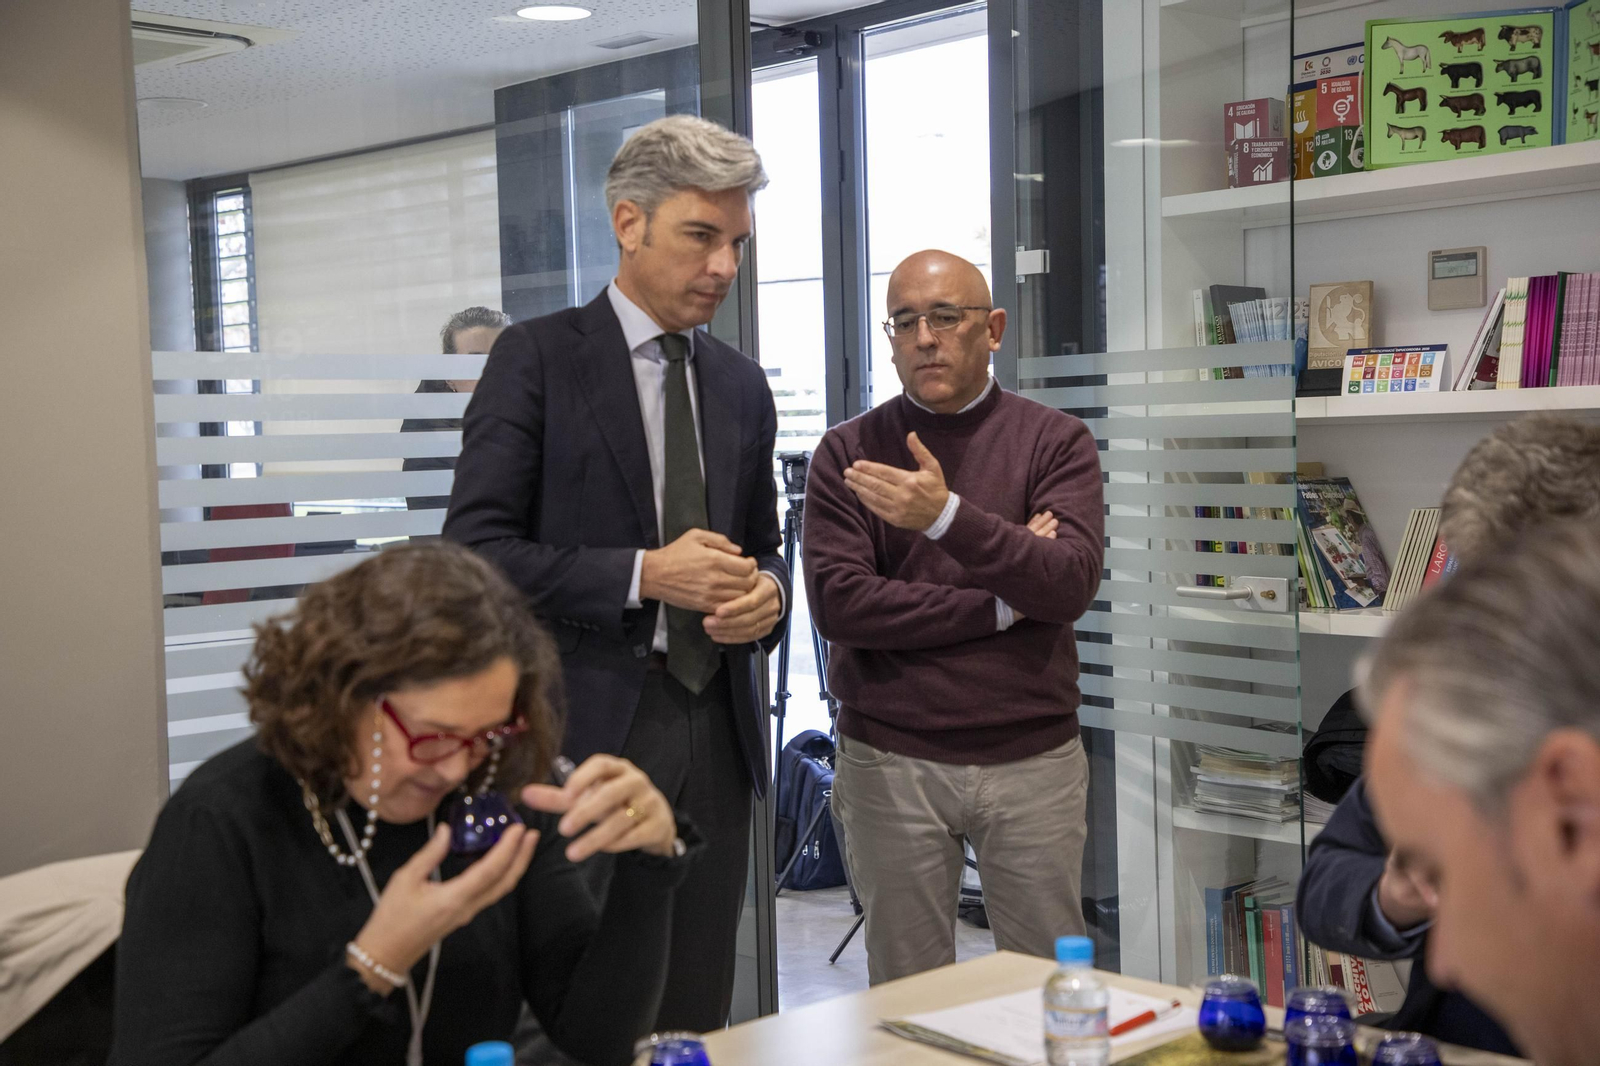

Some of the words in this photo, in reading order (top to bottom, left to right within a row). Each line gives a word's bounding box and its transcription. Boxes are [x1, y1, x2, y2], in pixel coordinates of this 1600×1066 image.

[1321, 83, 1327, 94] 5
[1228, 106, 1233, 117] 4
[1344, 129, 1353, 140] 13
[1306, 141, 1314, 152] 12
[1315, 135, 1320, 147] 13
[1243, 142, 1249, 153] 8
[1311, 359, 1343, 367] AVICO
